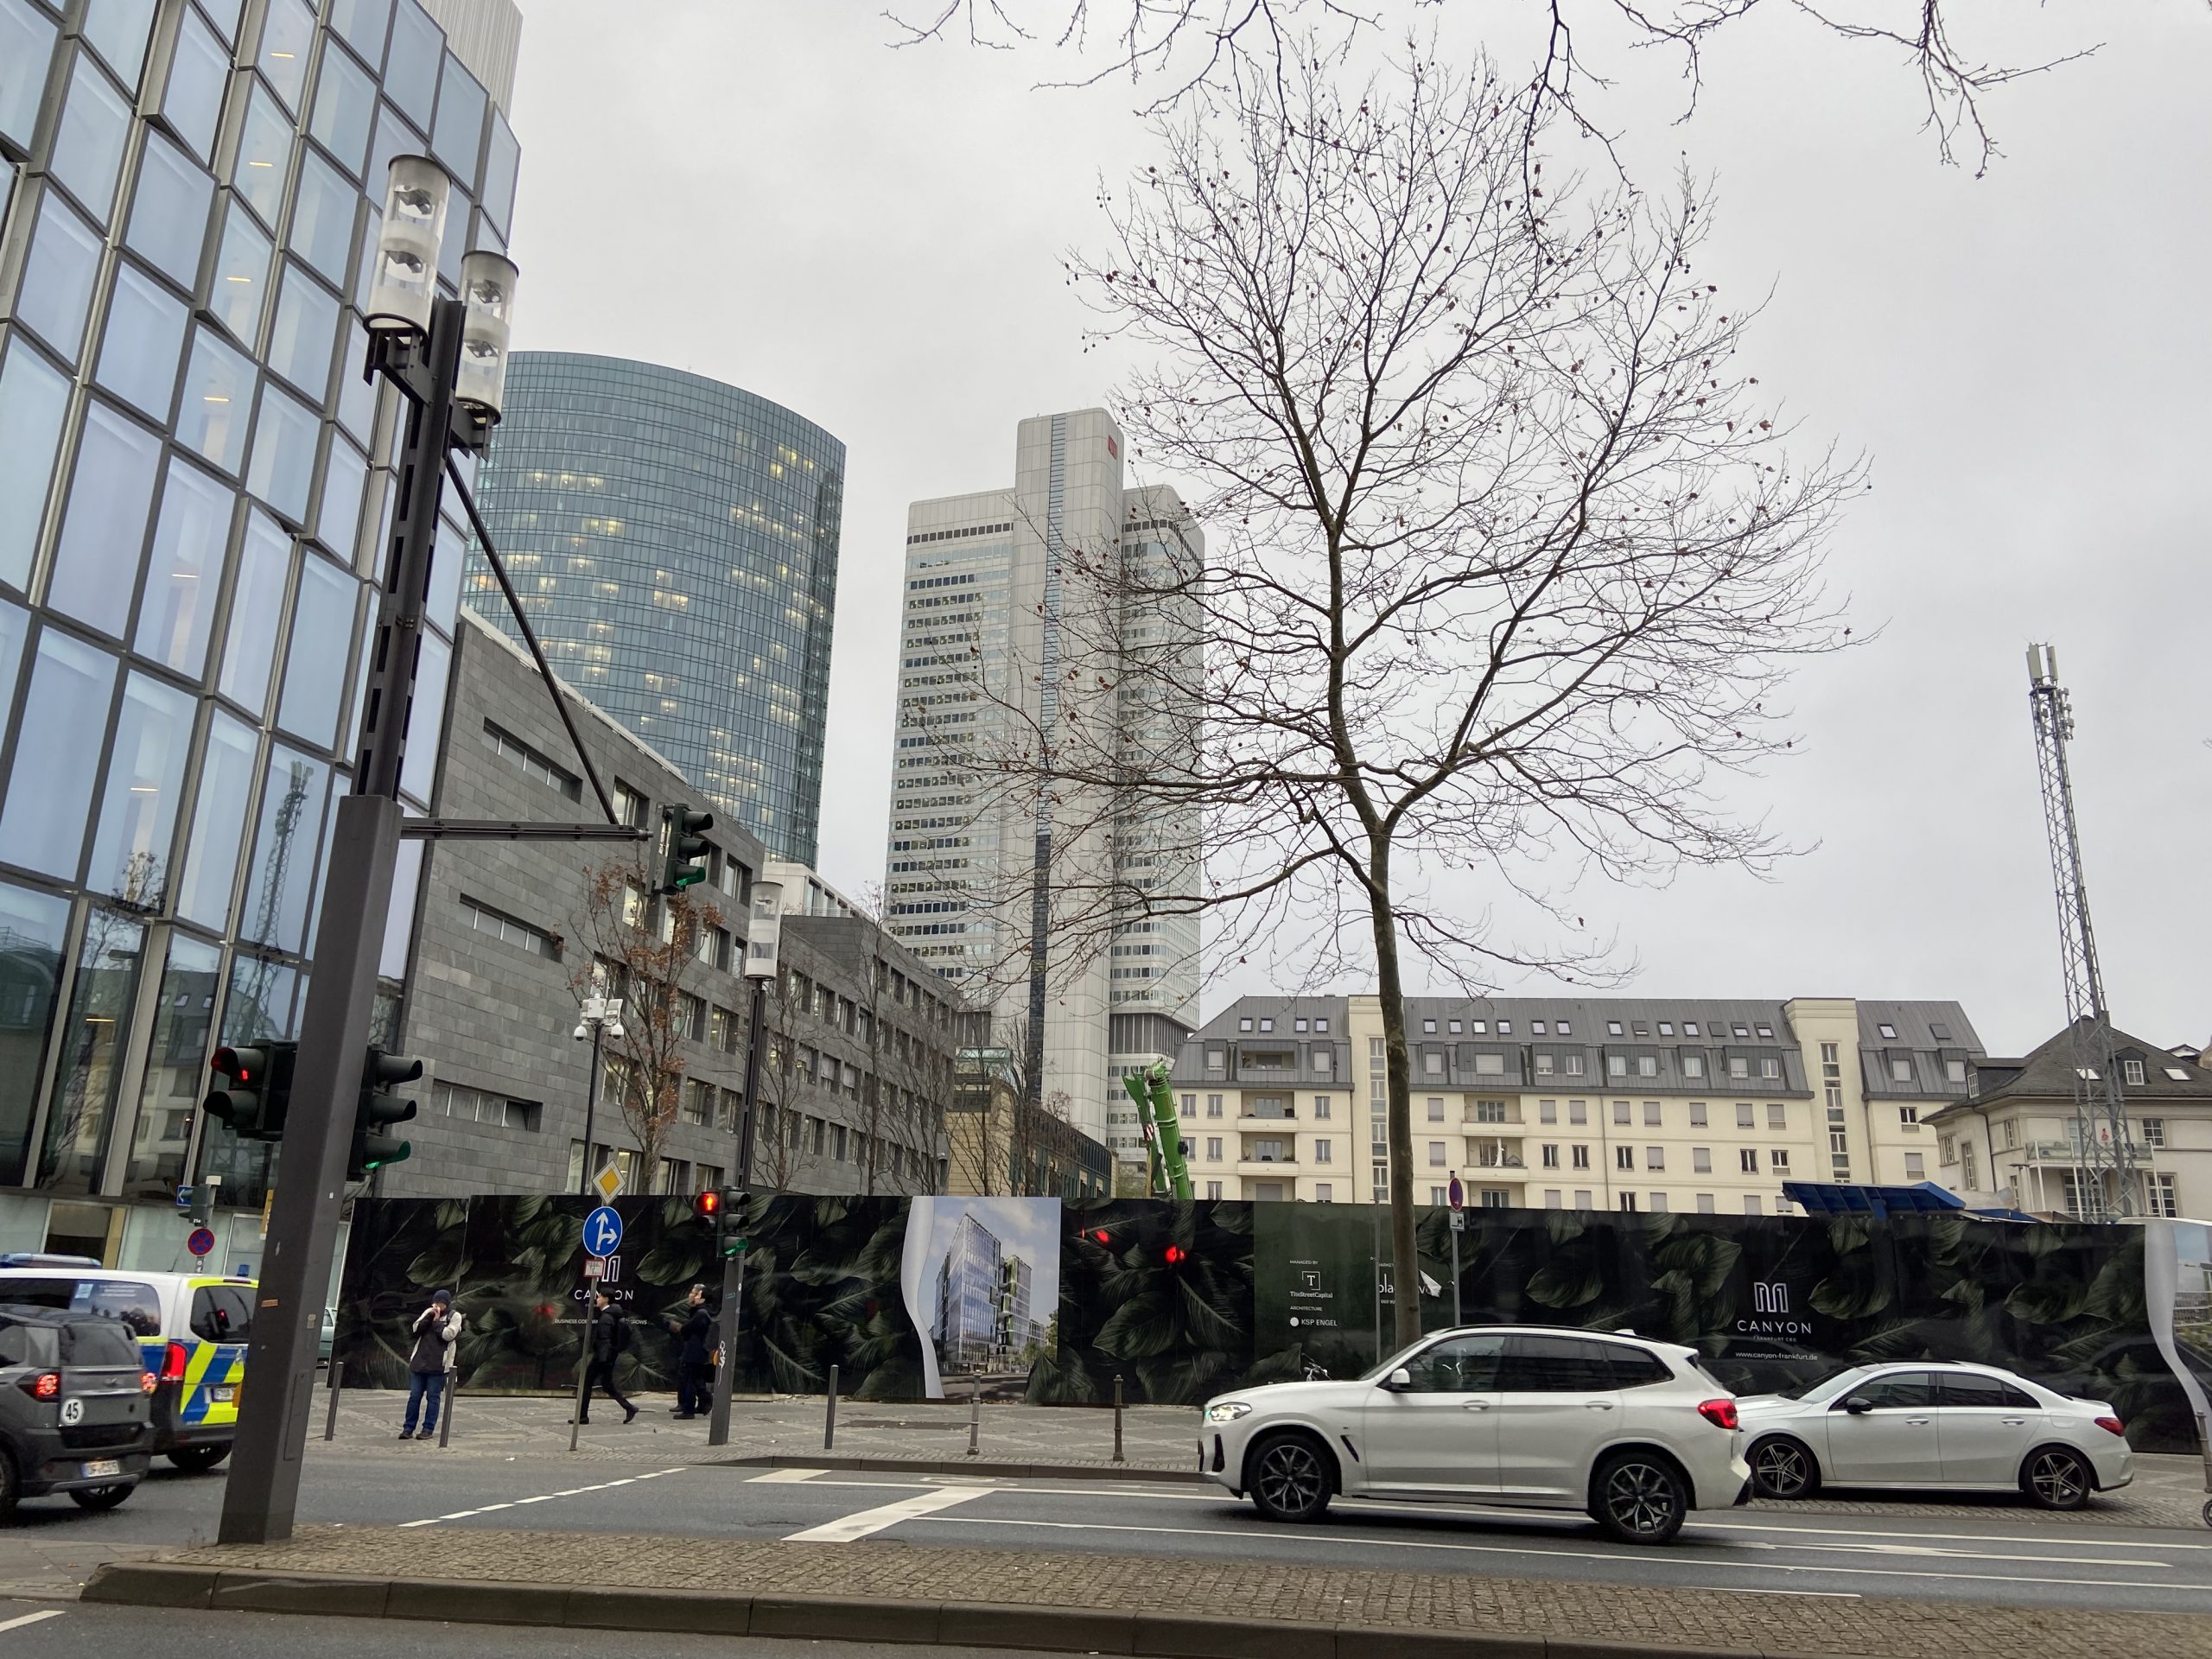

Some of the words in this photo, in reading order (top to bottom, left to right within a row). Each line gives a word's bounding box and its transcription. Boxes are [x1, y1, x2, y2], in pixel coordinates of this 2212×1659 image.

[1737, 1319, 1812, 1334] CANYON
[1735, 1351, 1818, 1361] www.canyon-frankfurt.de
[66, 1402, 79, 1420] 45
